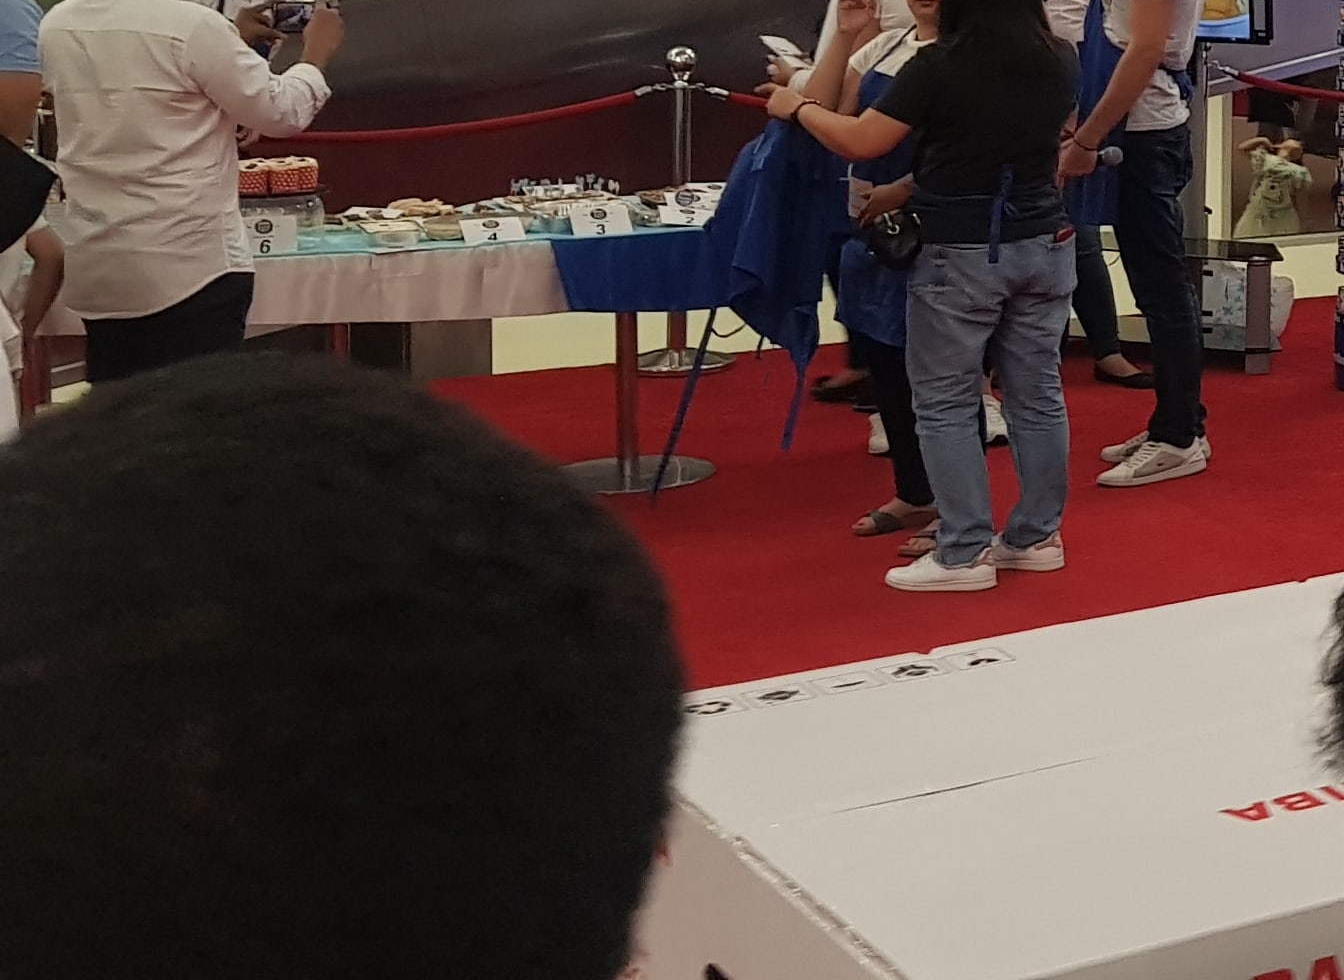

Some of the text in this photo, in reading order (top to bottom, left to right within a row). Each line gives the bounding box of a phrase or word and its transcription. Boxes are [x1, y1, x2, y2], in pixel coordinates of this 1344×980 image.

[596, 223, 606, 235] 3
[487, 232, 499, 242] 4
[259, 238, 271, 254] 6
